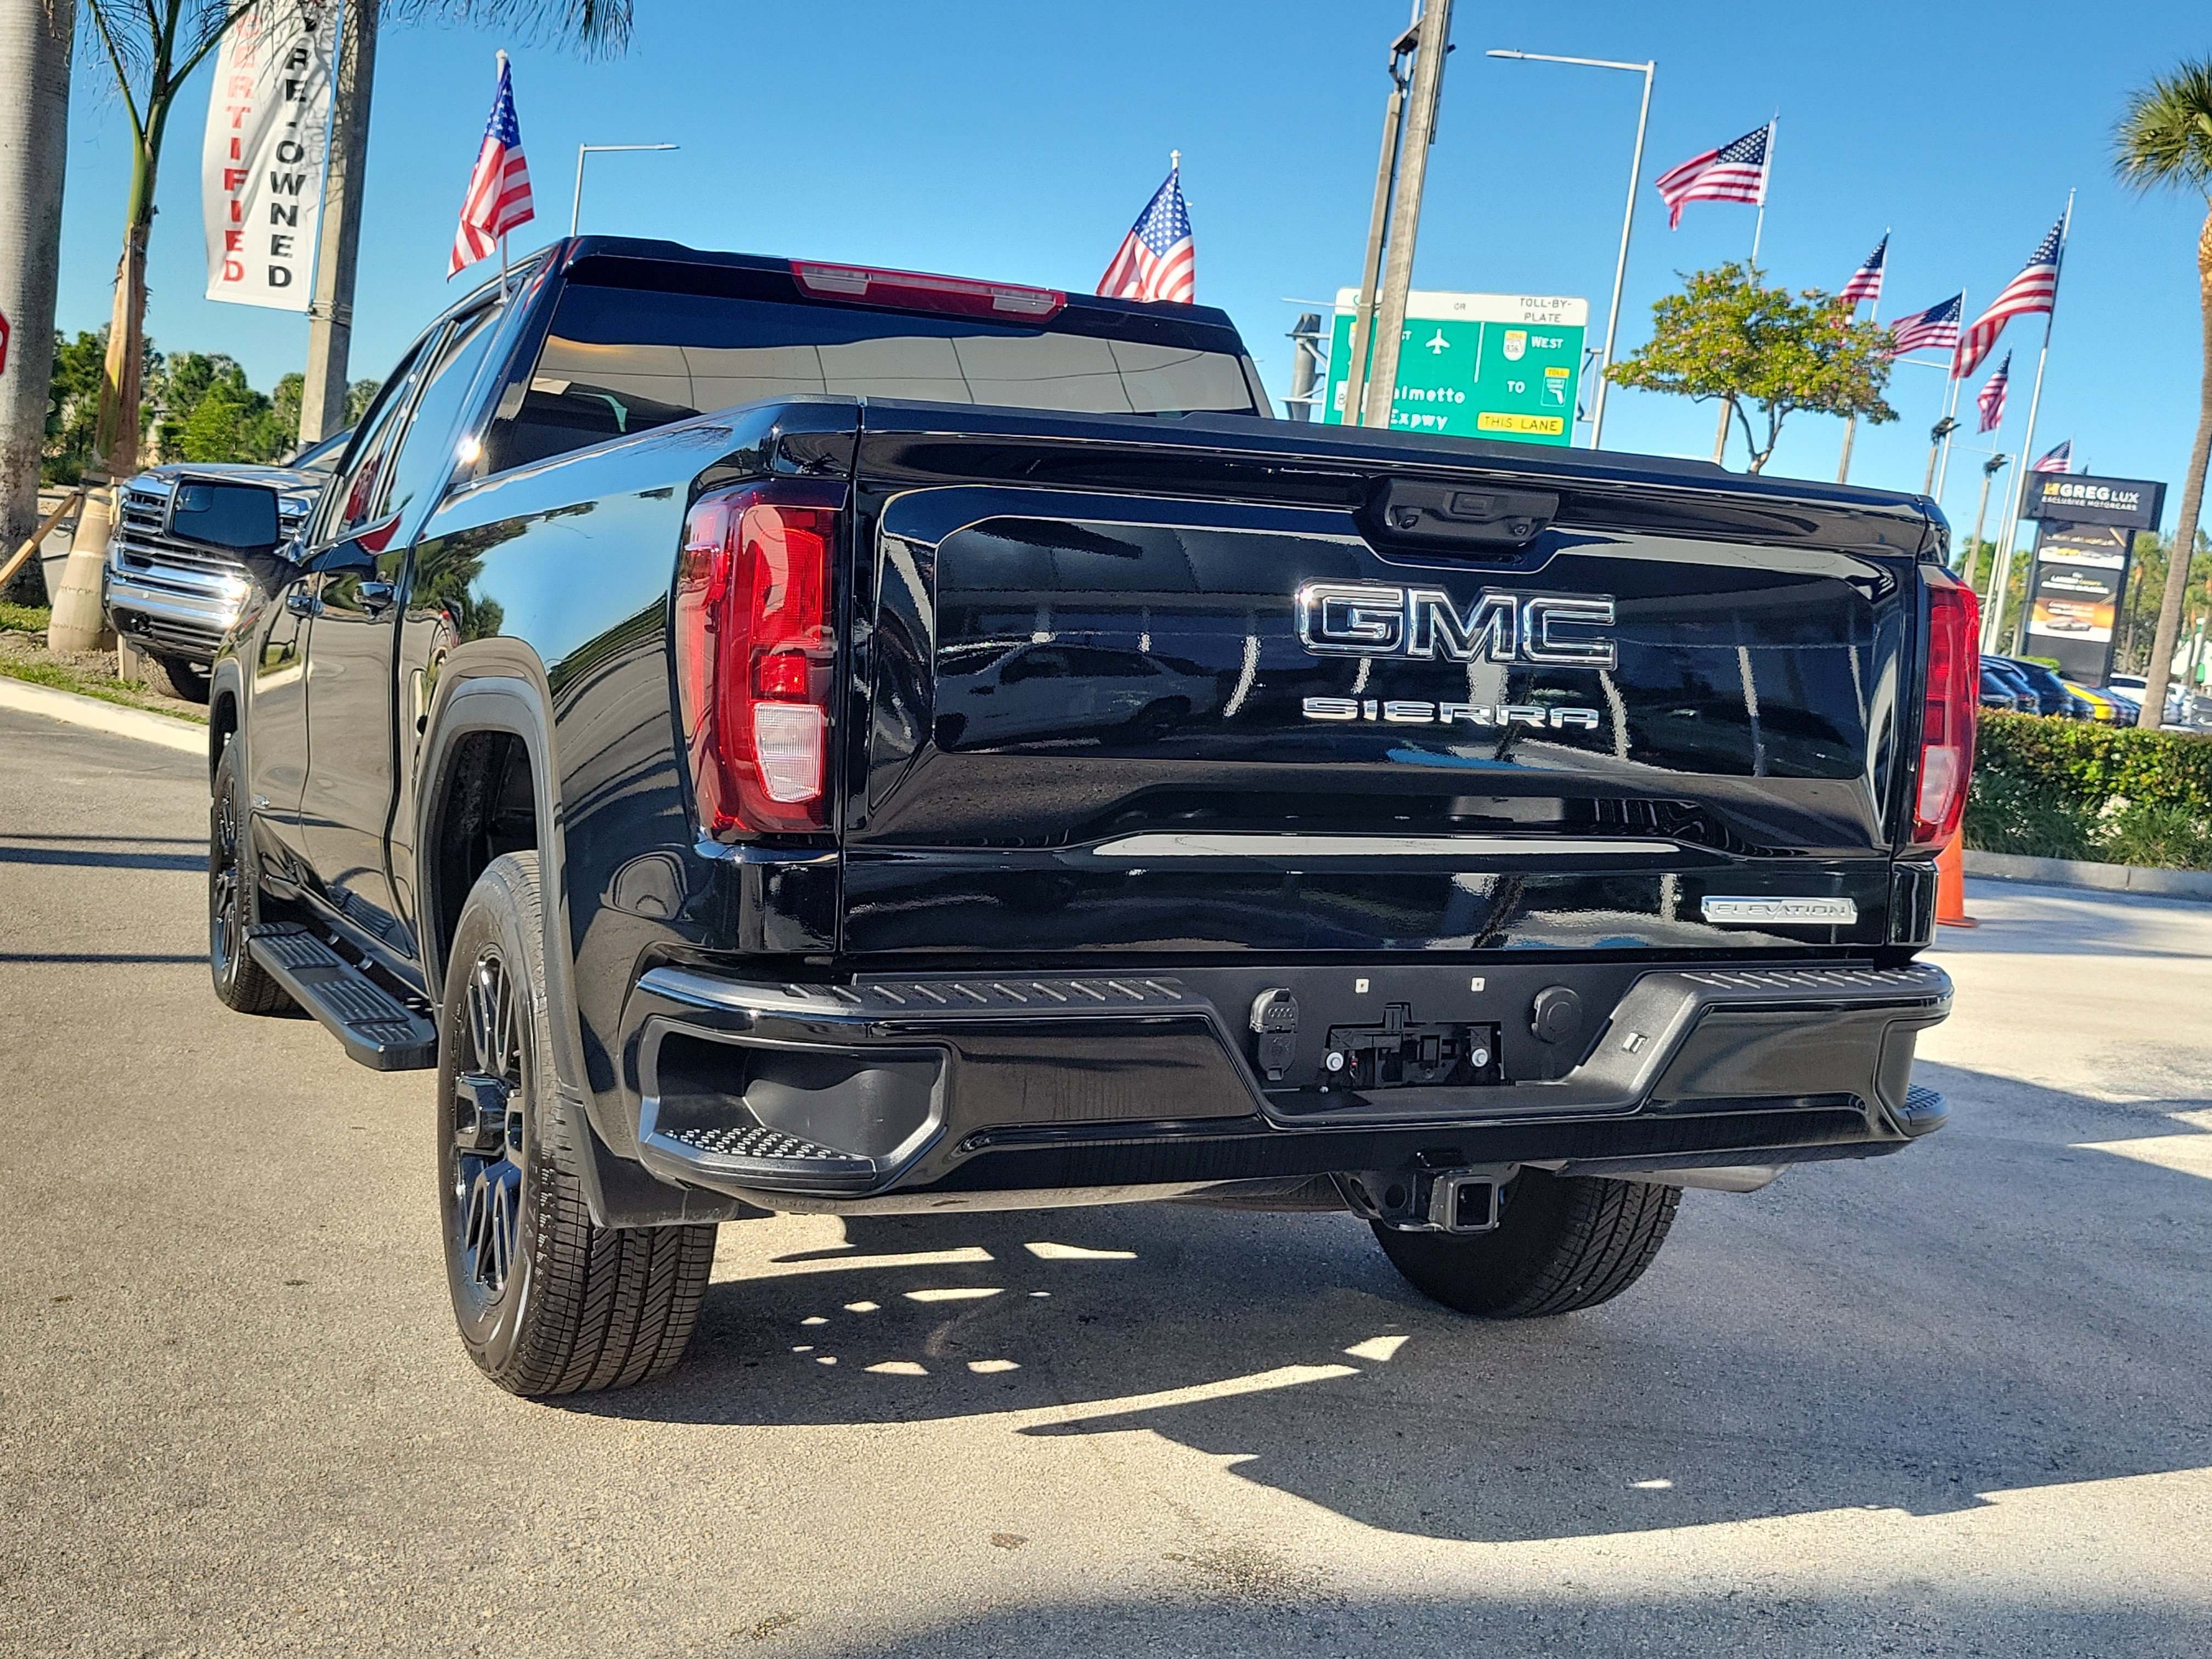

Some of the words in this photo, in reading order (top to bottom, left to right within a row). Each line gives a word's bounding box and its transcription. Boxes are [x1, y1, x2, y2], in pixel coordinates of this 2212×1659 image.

[223, 14, 262, 281] CERTIFIED
[1454, 302, 1466, 311] OR
[1520, 297, 1573, 308] TOLL-BY-
[1524, 312, 1561, 323] PLATE
[1531, 336, 1564, 348] WEST
[1507, 380, 1525, 393] TO
[1390, 408, 1448, 431] Expwy
[1485, 416, 1512, 428] THIS
[1521, 419, 1558, 432] LANE
[2060, 483, 2110, 500] GREG
[2111, 490, 2141, 504] LUX
[1295, 577, 1618, 671] GMC
[1302, 697, 1599, 730] SIERRA
[1714, 904, 1846, 917] ELEVATION
